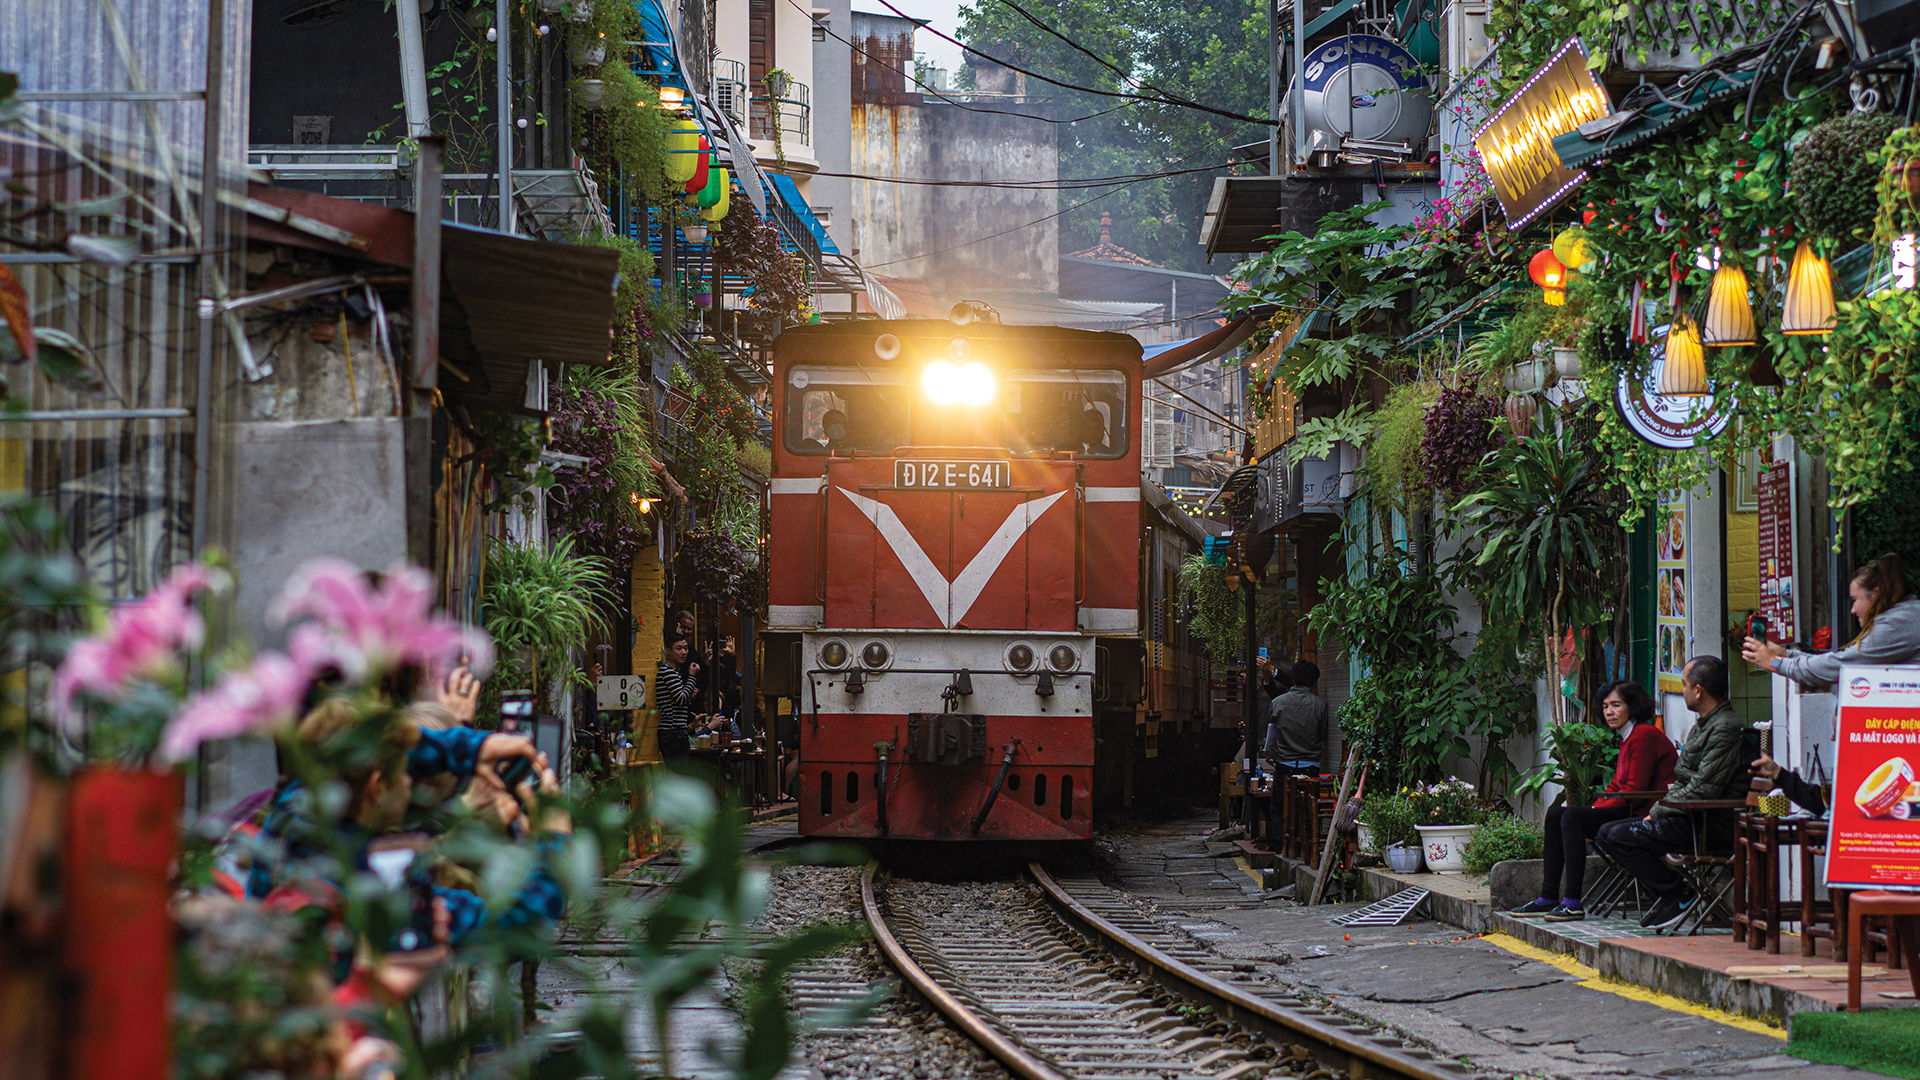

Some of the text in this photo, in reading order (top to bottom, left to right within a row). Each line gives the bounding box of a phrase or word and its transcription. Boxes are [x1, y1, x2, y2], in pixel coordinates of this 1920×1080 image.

[1866, 718, 1920, 731] DÂY CÁP ĐIỆN
[1850, 733, 1861, 742] RA
[1863, 731, 1881, 742] MẮT
[1882, 733, 1904, 743] LOGO
[1906, 732, 1916, 744] VÀ
